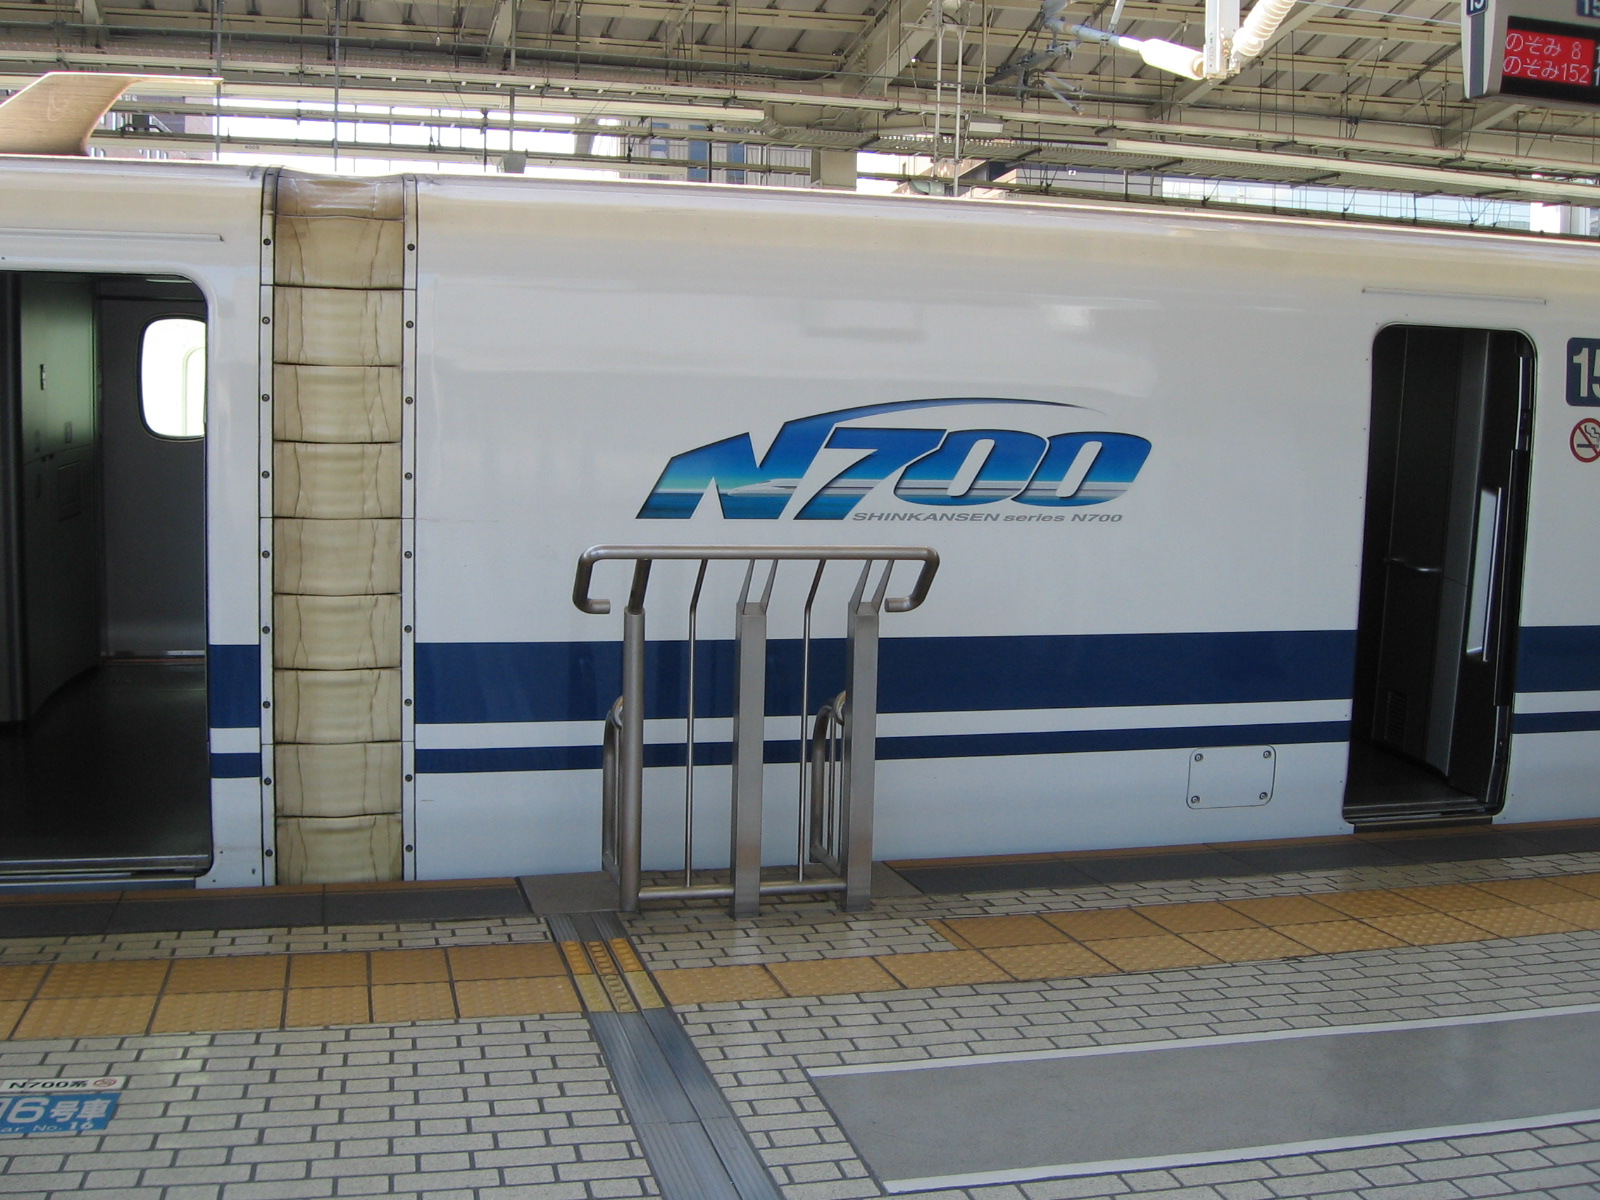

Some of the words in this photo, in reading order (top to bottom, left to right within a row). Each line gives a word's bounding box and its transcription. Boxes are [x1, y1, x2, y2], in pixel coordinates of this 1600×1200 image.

[1505, 33, 1561, 57] のぞみ
[1571, 41, 1582, 60] 8
[636, 397, 1152, 520] N700
[852, 512, 1000, 522] SHINKANSEN
[1003, 513, 1064, 523] series
[1071, 513, 1123, 523] N700
[9, 1080, 88, 1089] N700系
[69, 1121, 94, 1130] 16
